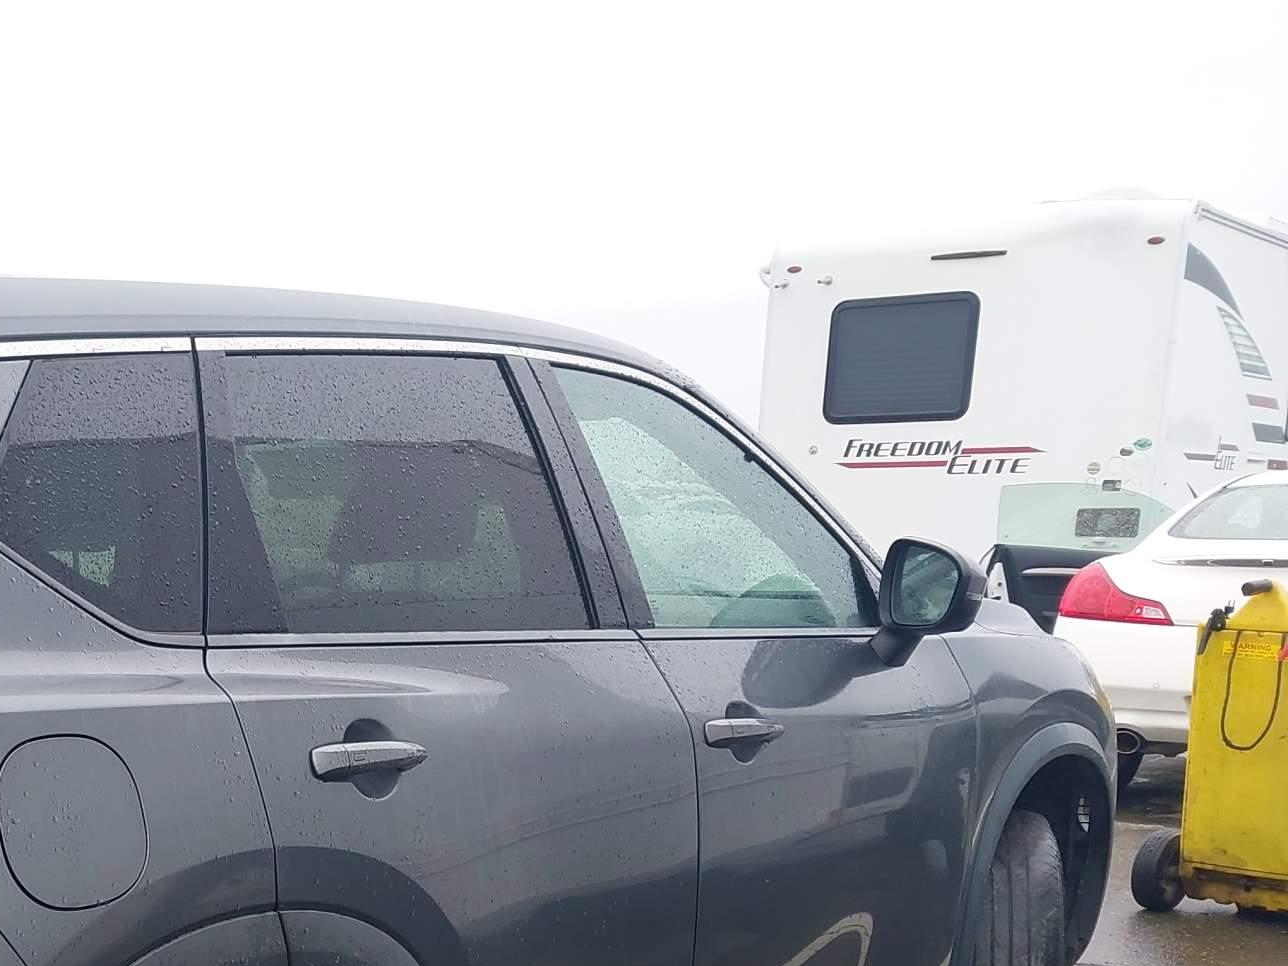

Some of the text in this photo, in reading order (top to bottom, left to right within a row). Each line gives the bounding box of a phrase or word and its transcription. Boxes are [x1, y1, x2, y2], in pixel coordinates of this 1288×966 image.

[843, 438, 963, 458] FREEDOM
[947, 455, 1031, 475] ELITE
[1214, 450, 1237, 471] ELITE
